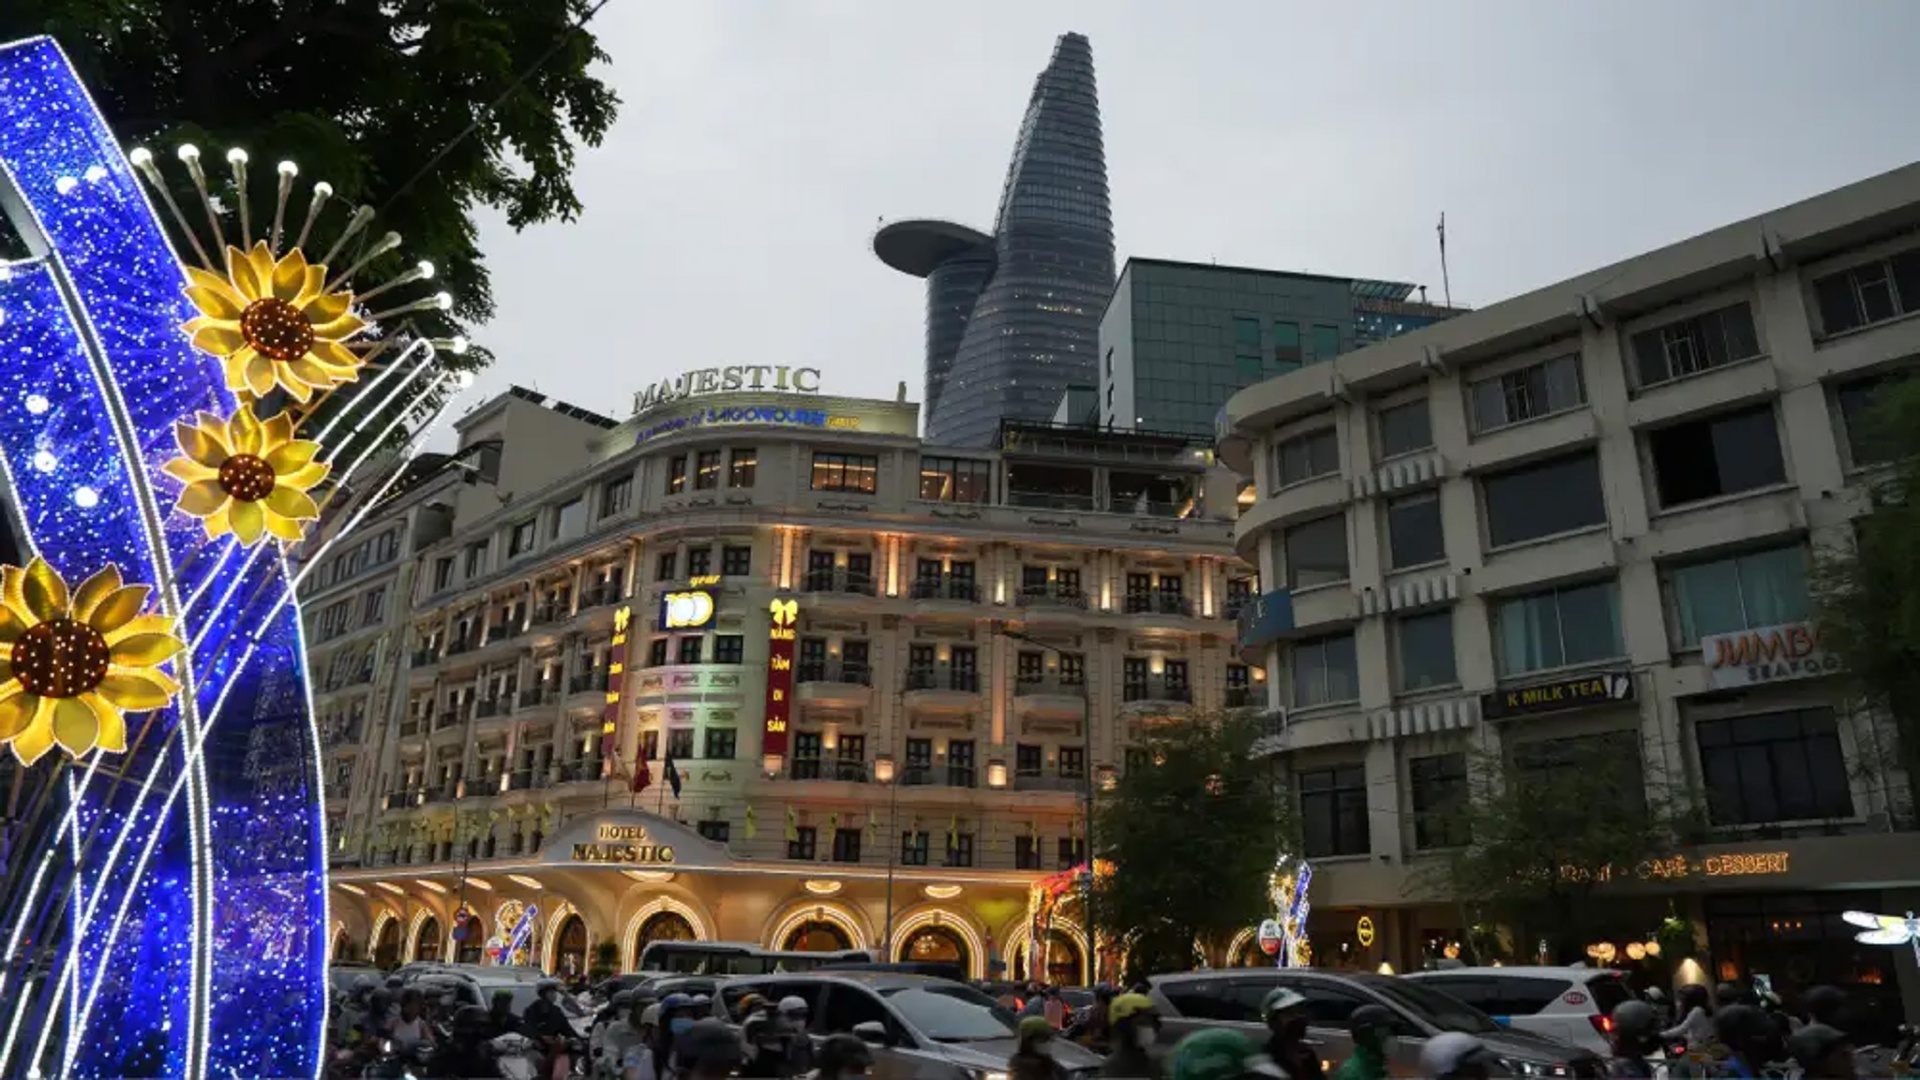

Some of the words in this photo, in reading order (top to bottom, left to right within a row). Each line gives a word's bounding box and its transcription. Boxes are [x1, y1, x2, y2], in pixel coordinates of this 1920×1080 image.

[631, 366, 821, 414] MAJESTIC
[689, 574, 721, 587] year
[664, 590, 714, 629] 100
[1713, 626, 1824, 669] JUMB
[1508, 690, 1519, 707] K
[1522, 687, 1564, 705] MILK
[1569, 680, 1604, 698] TEA
[599, 825, 646, 839] HOTEL
[572, 844, 674, 862] MAJESTIC
[1706, 852, 1789, 876] DESSERT
